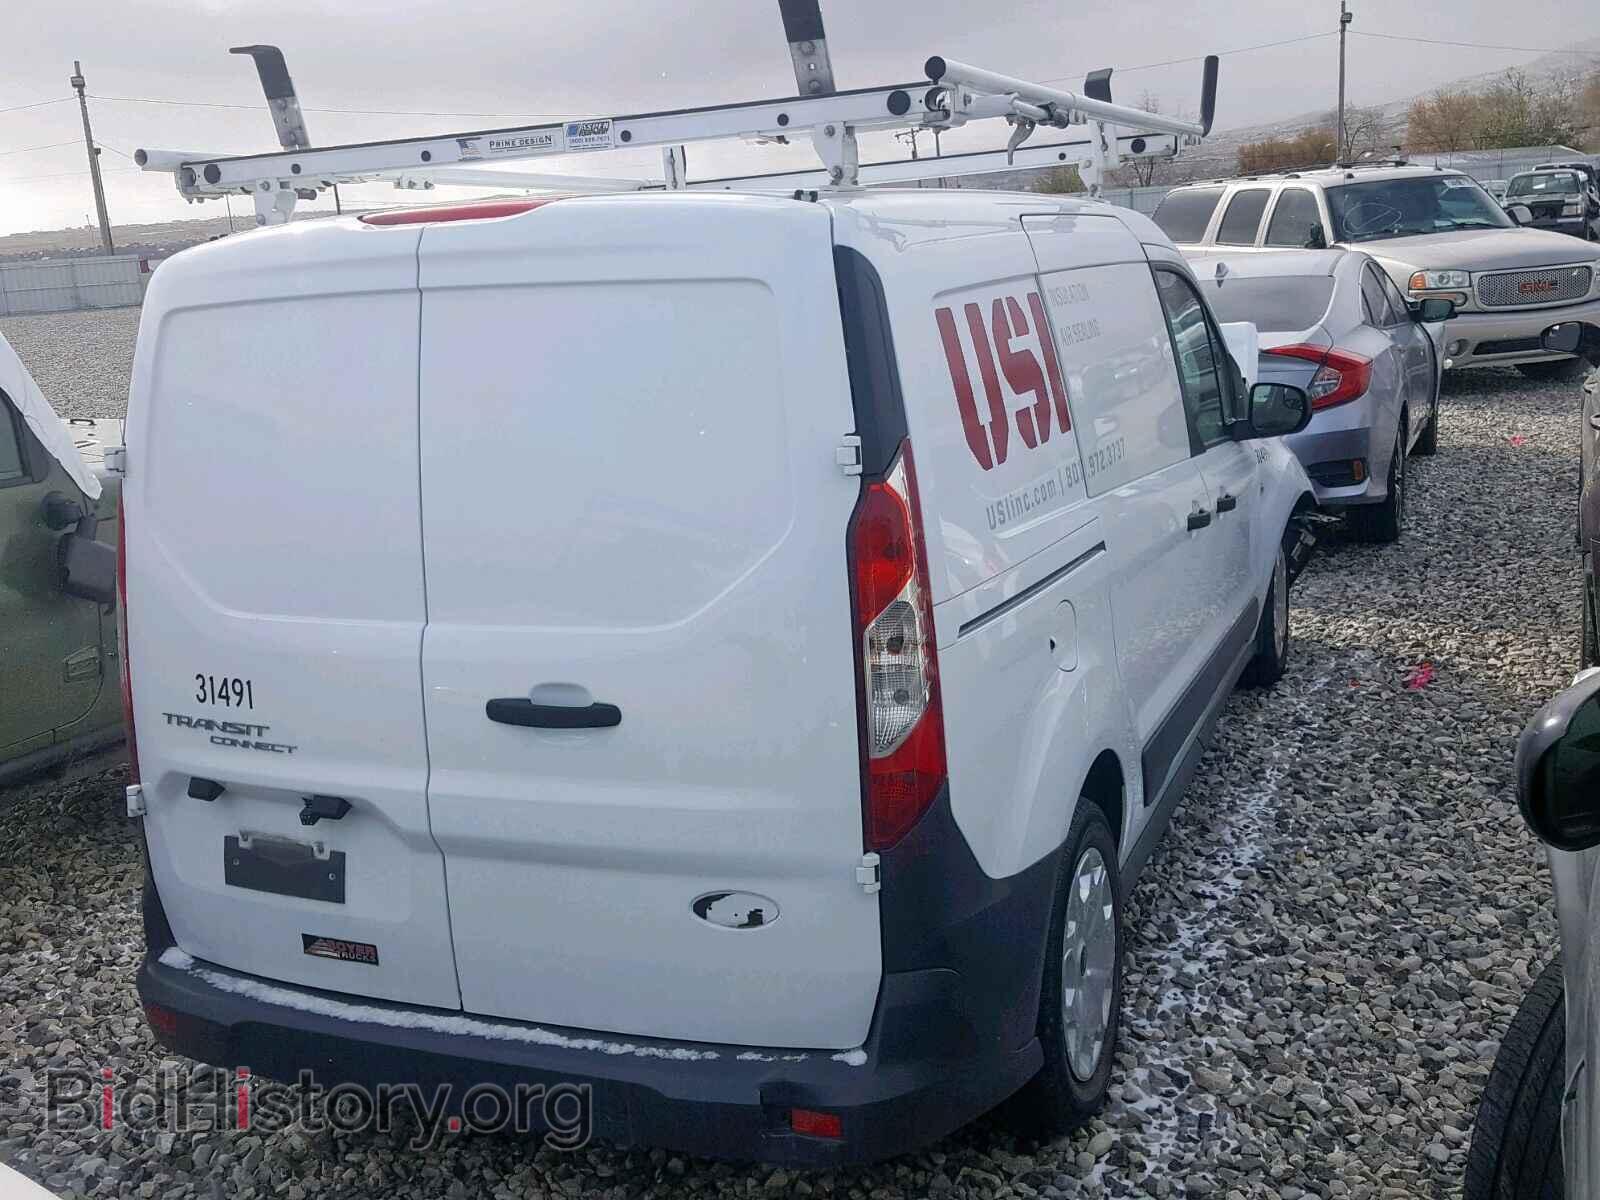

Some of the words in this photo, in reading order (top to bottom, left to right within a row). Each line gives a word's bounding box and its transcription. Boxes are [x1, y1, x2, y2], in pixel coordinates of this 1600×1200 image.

[489, 139, 516, 149] PRIME
[519, 135, 552, 145] DESIGN
[1519, 279, 1558, 293] GMC
[935, 291, 1071, 471] USI
[195, 673, 253, 709] 31491
[162, 712, 270, 737] TRANSIT
[210, 735, 298, 754] CONNECT
